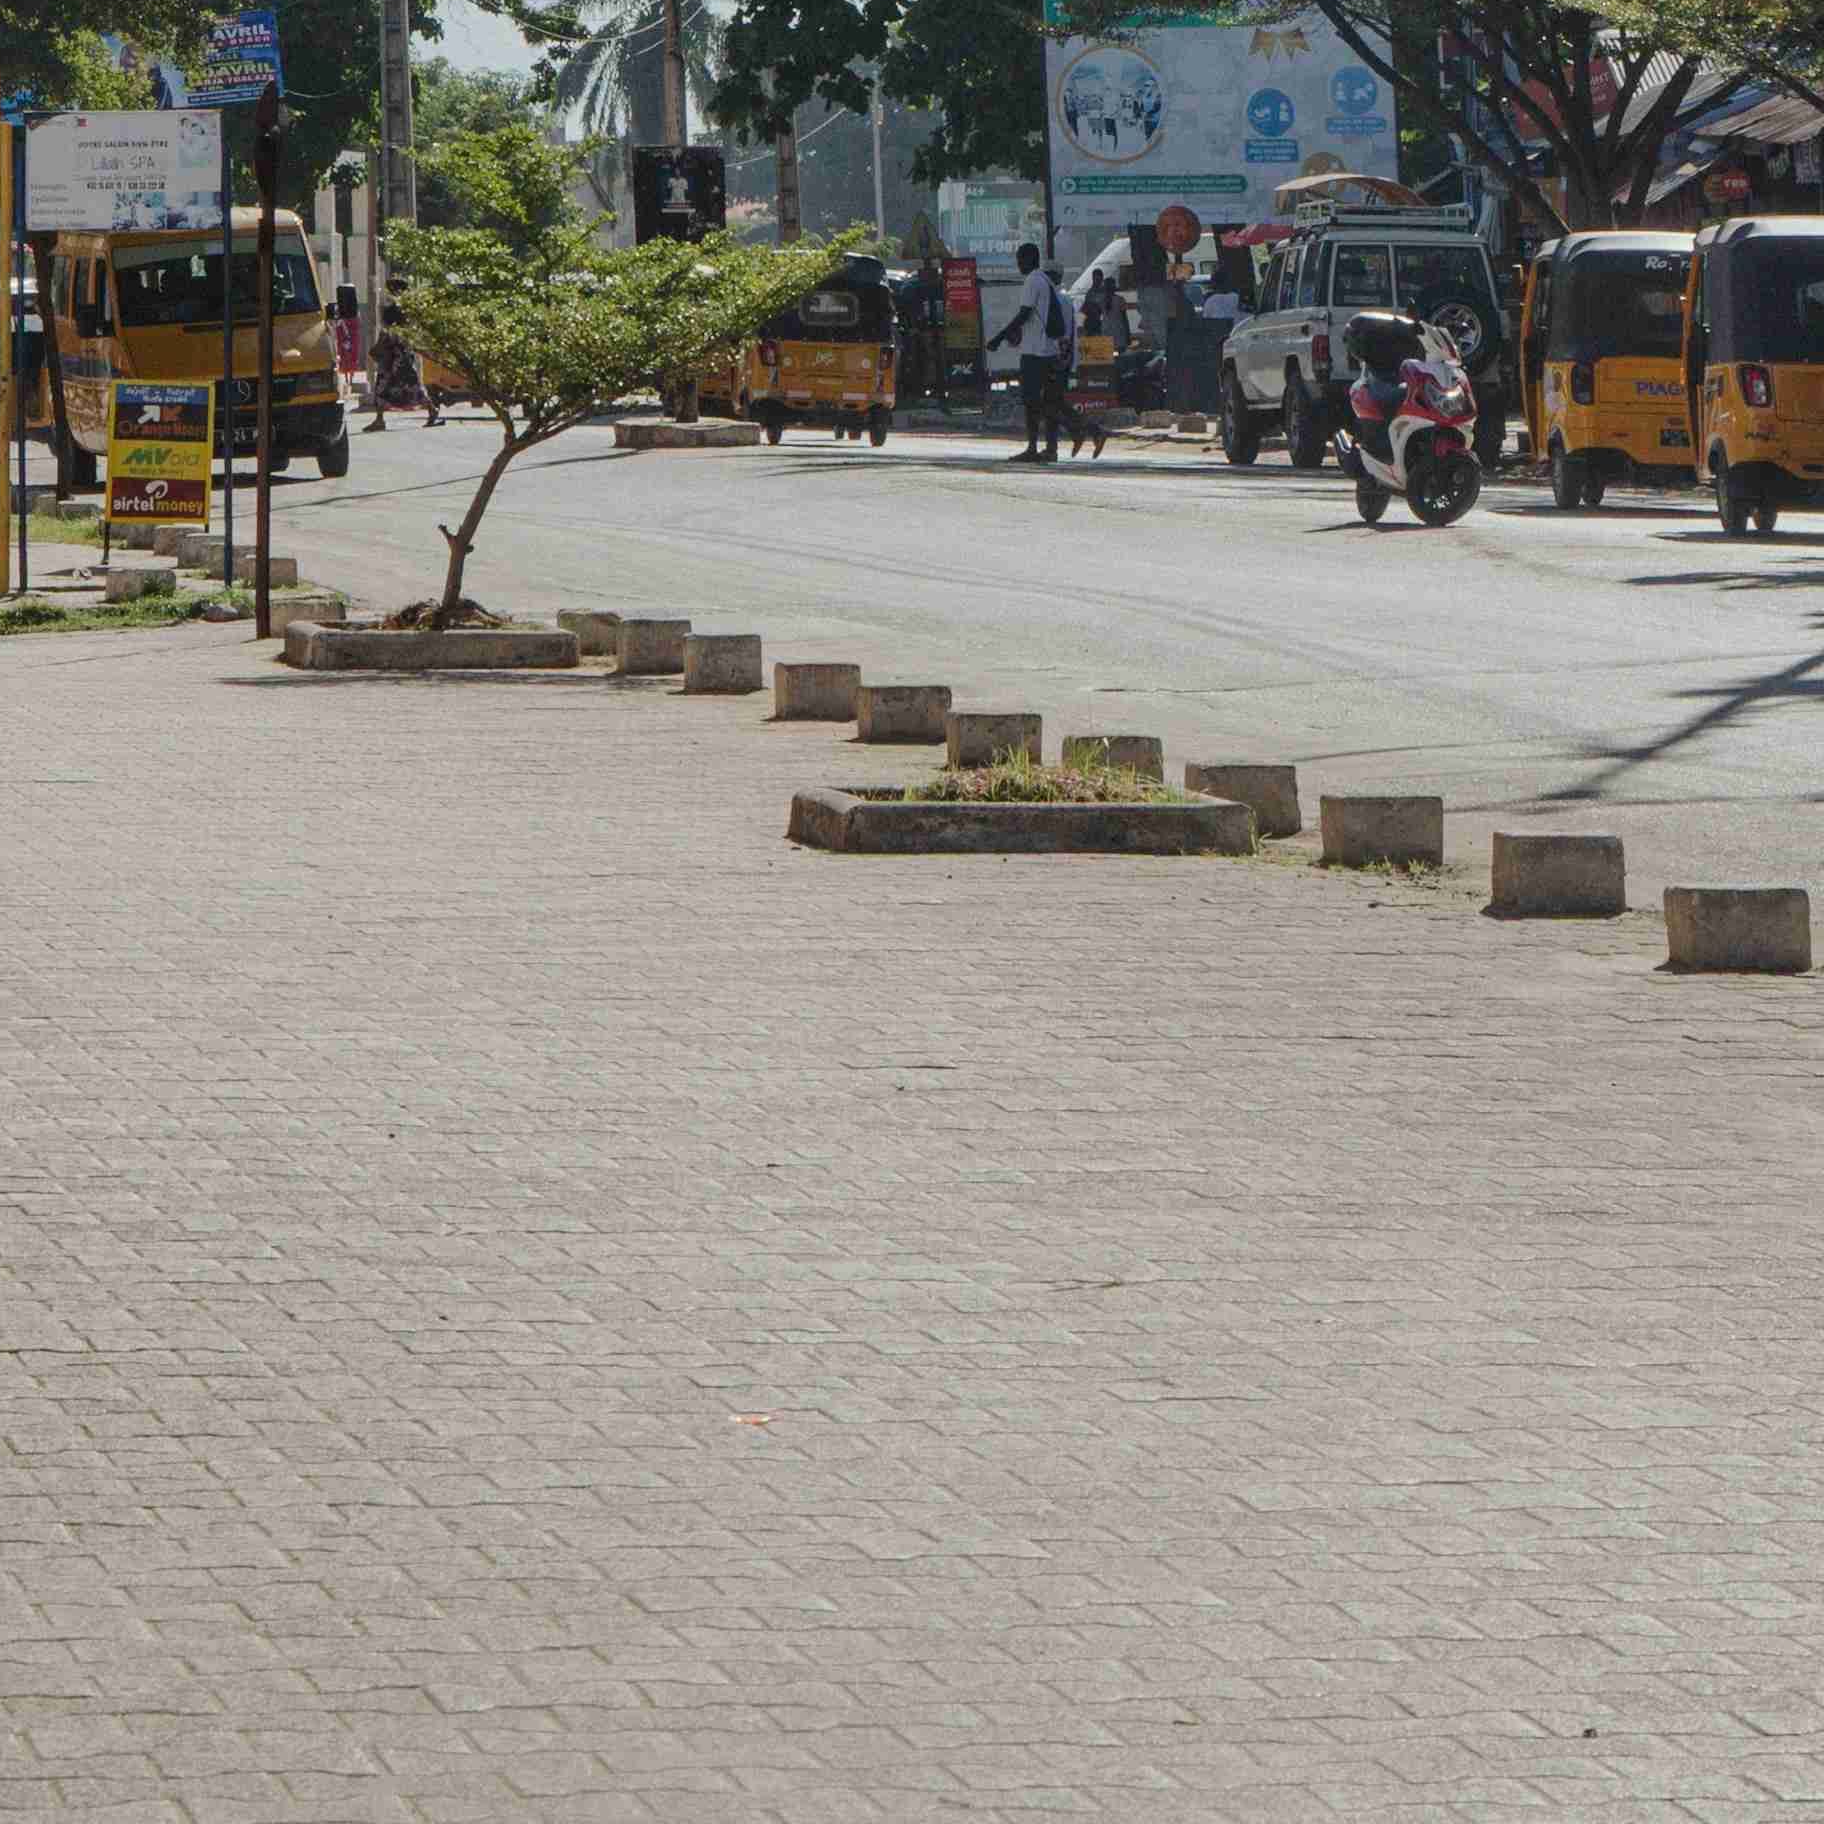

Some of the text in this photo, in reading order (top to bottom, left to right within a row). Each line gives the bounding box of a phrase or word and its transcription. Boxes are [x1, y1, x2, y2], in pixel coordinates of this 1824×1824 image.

[1635, 381, 1684, 396] PIAG
[112, 496, 203, 515] airtel money
